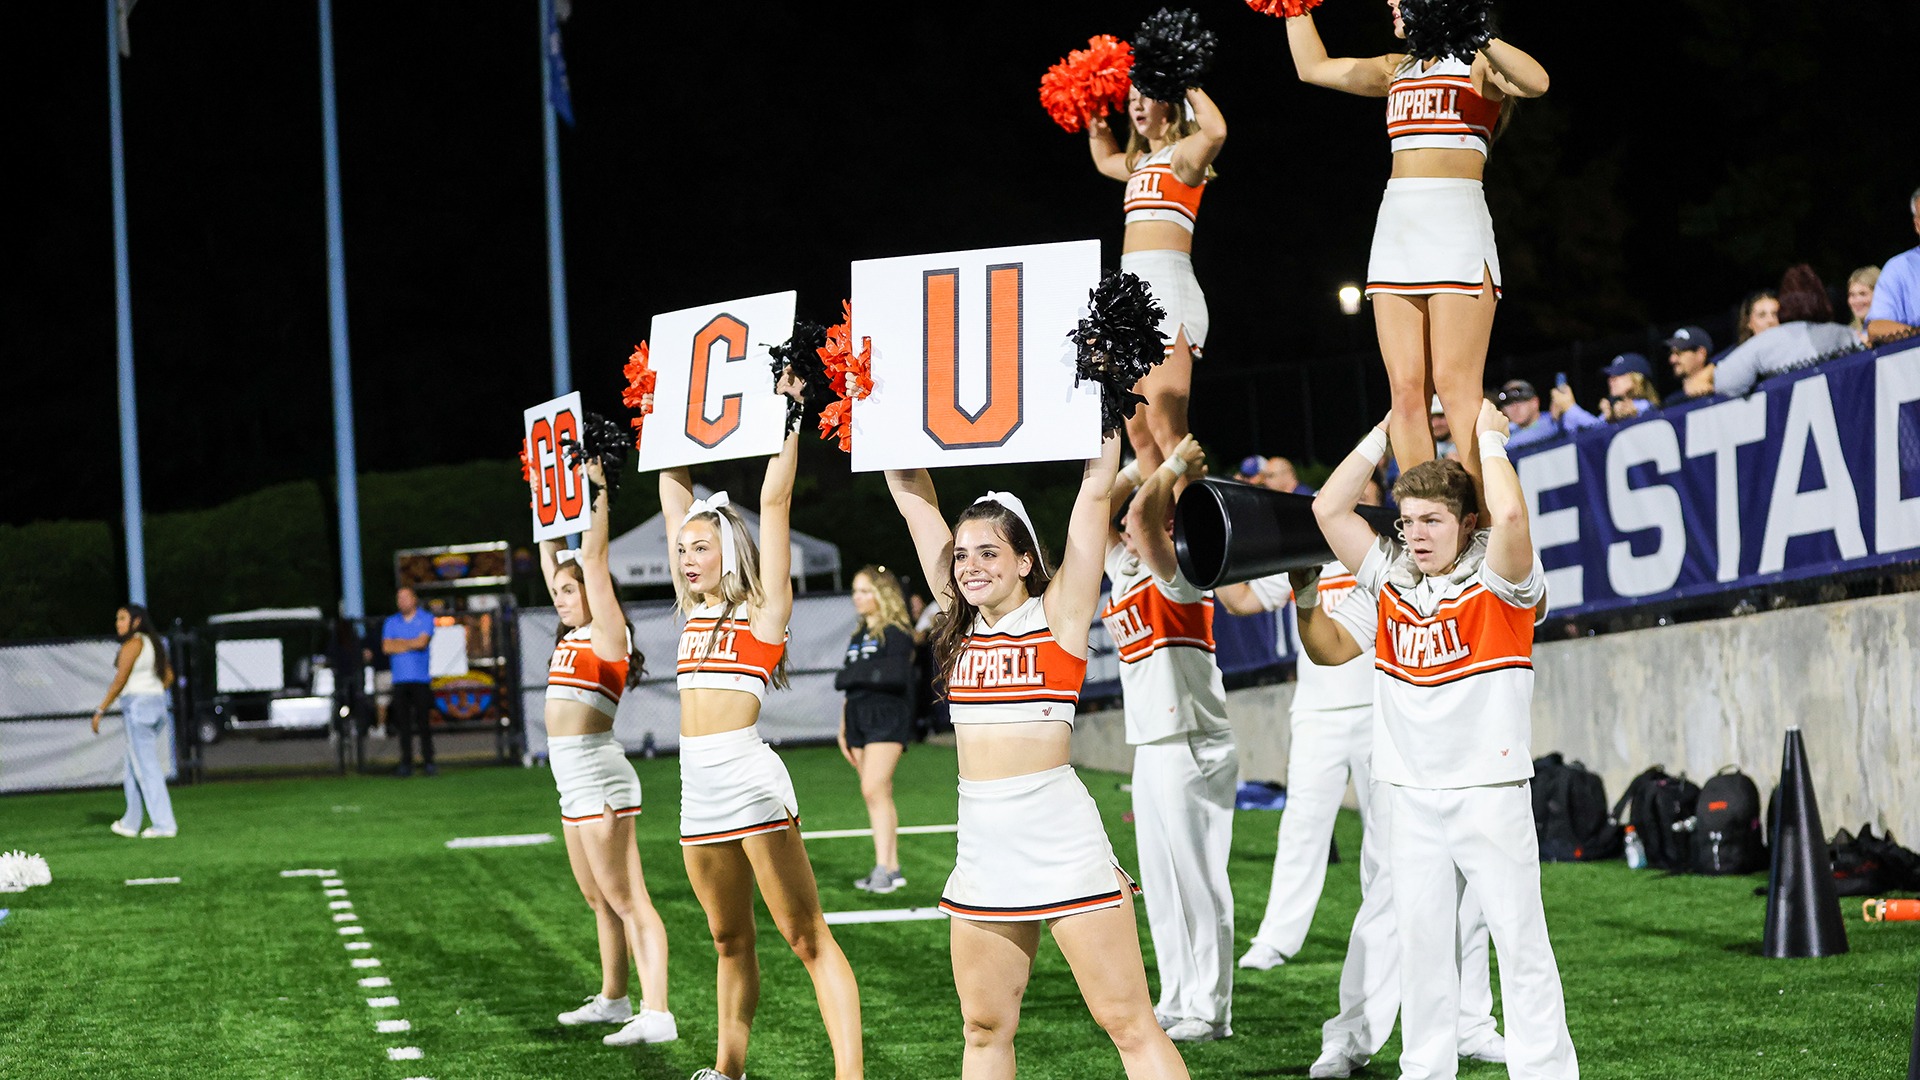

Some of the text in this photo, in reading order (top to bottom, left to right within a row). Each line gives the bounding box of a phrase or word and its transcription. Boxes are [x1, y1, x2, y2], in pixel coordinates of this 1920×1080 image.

[1387, 88, 1462, 124] AMPBELL
[684, 312, 750, 449] C
[922, 262, 1024, 451] U
[531, 407, 584, 527] GO
[949, 646, 1045, 689] AMPBELL
